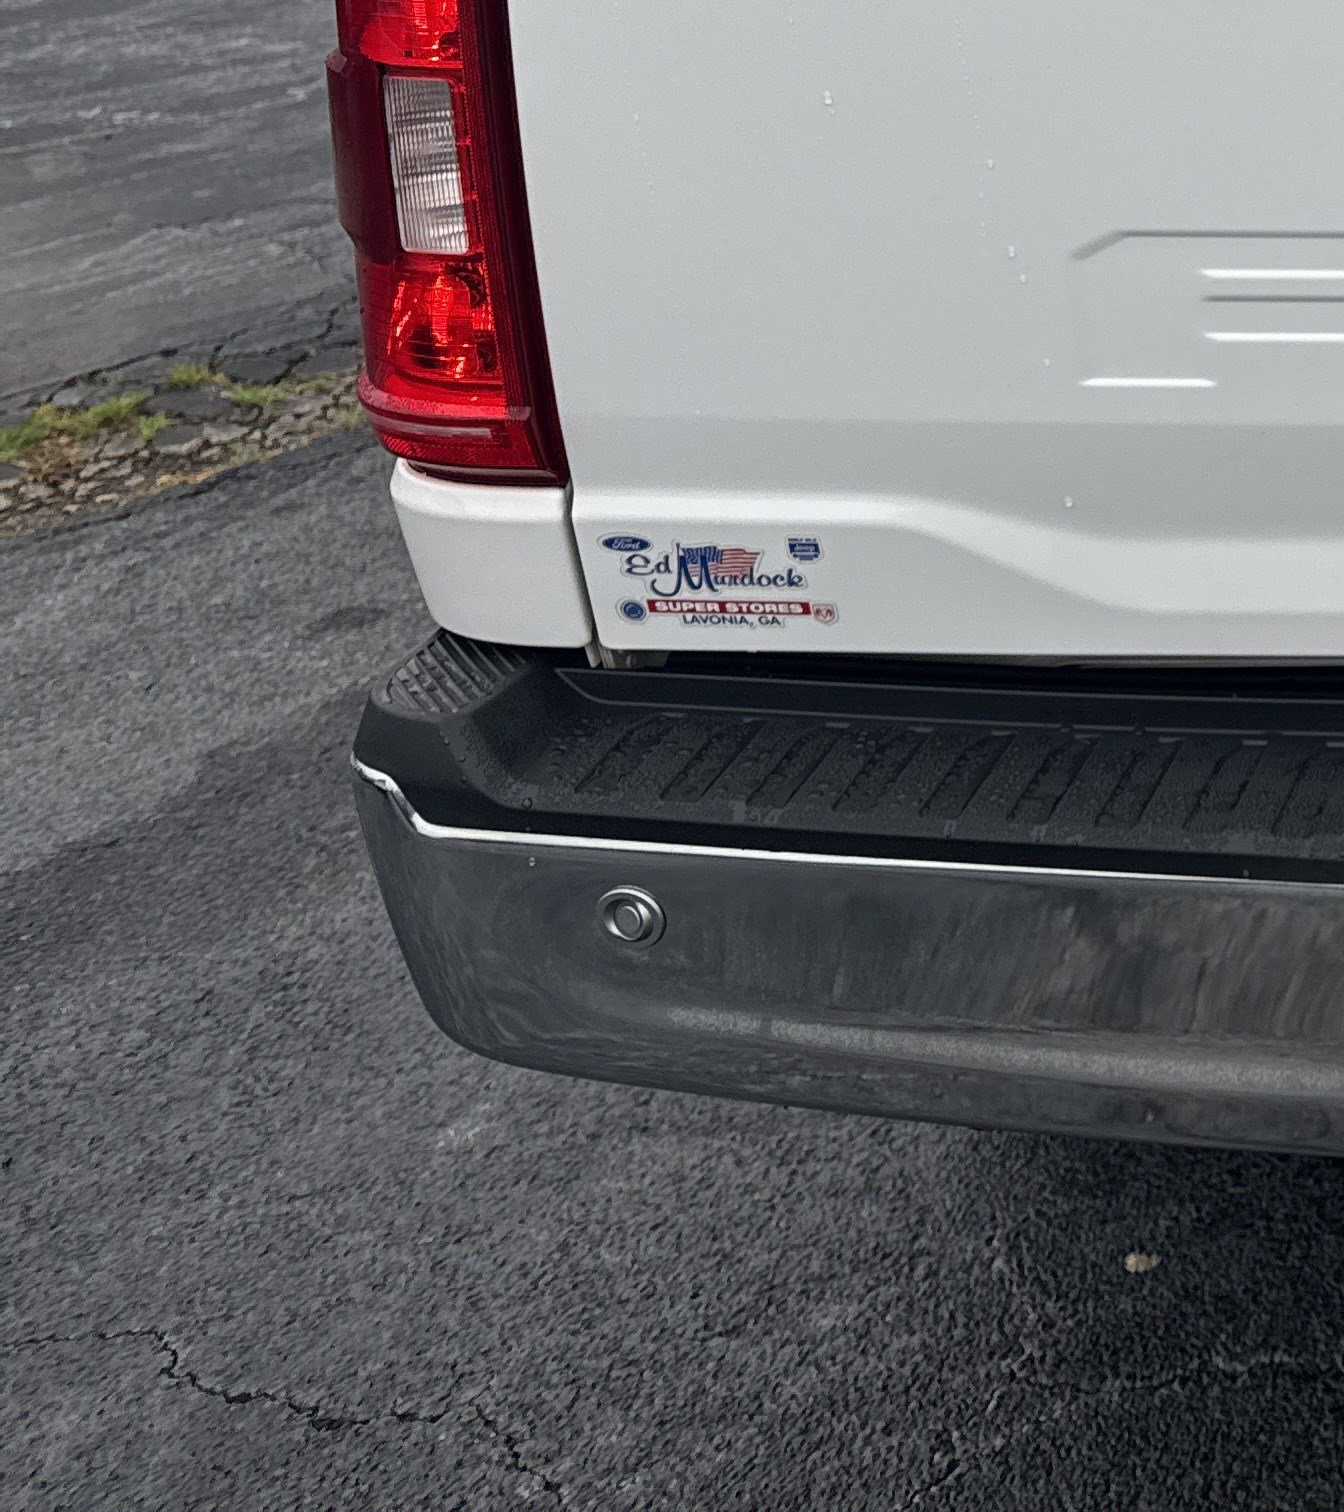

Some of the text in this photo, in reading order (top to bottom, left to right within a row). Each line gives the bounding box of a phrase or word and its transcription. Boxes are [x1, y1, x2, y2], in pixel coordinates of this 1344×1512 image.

[626, 552, 803, 597] Ed Murdock
[654, 600, 804, 614] SUPER STORES
[757, 615, 782, 626] GA
